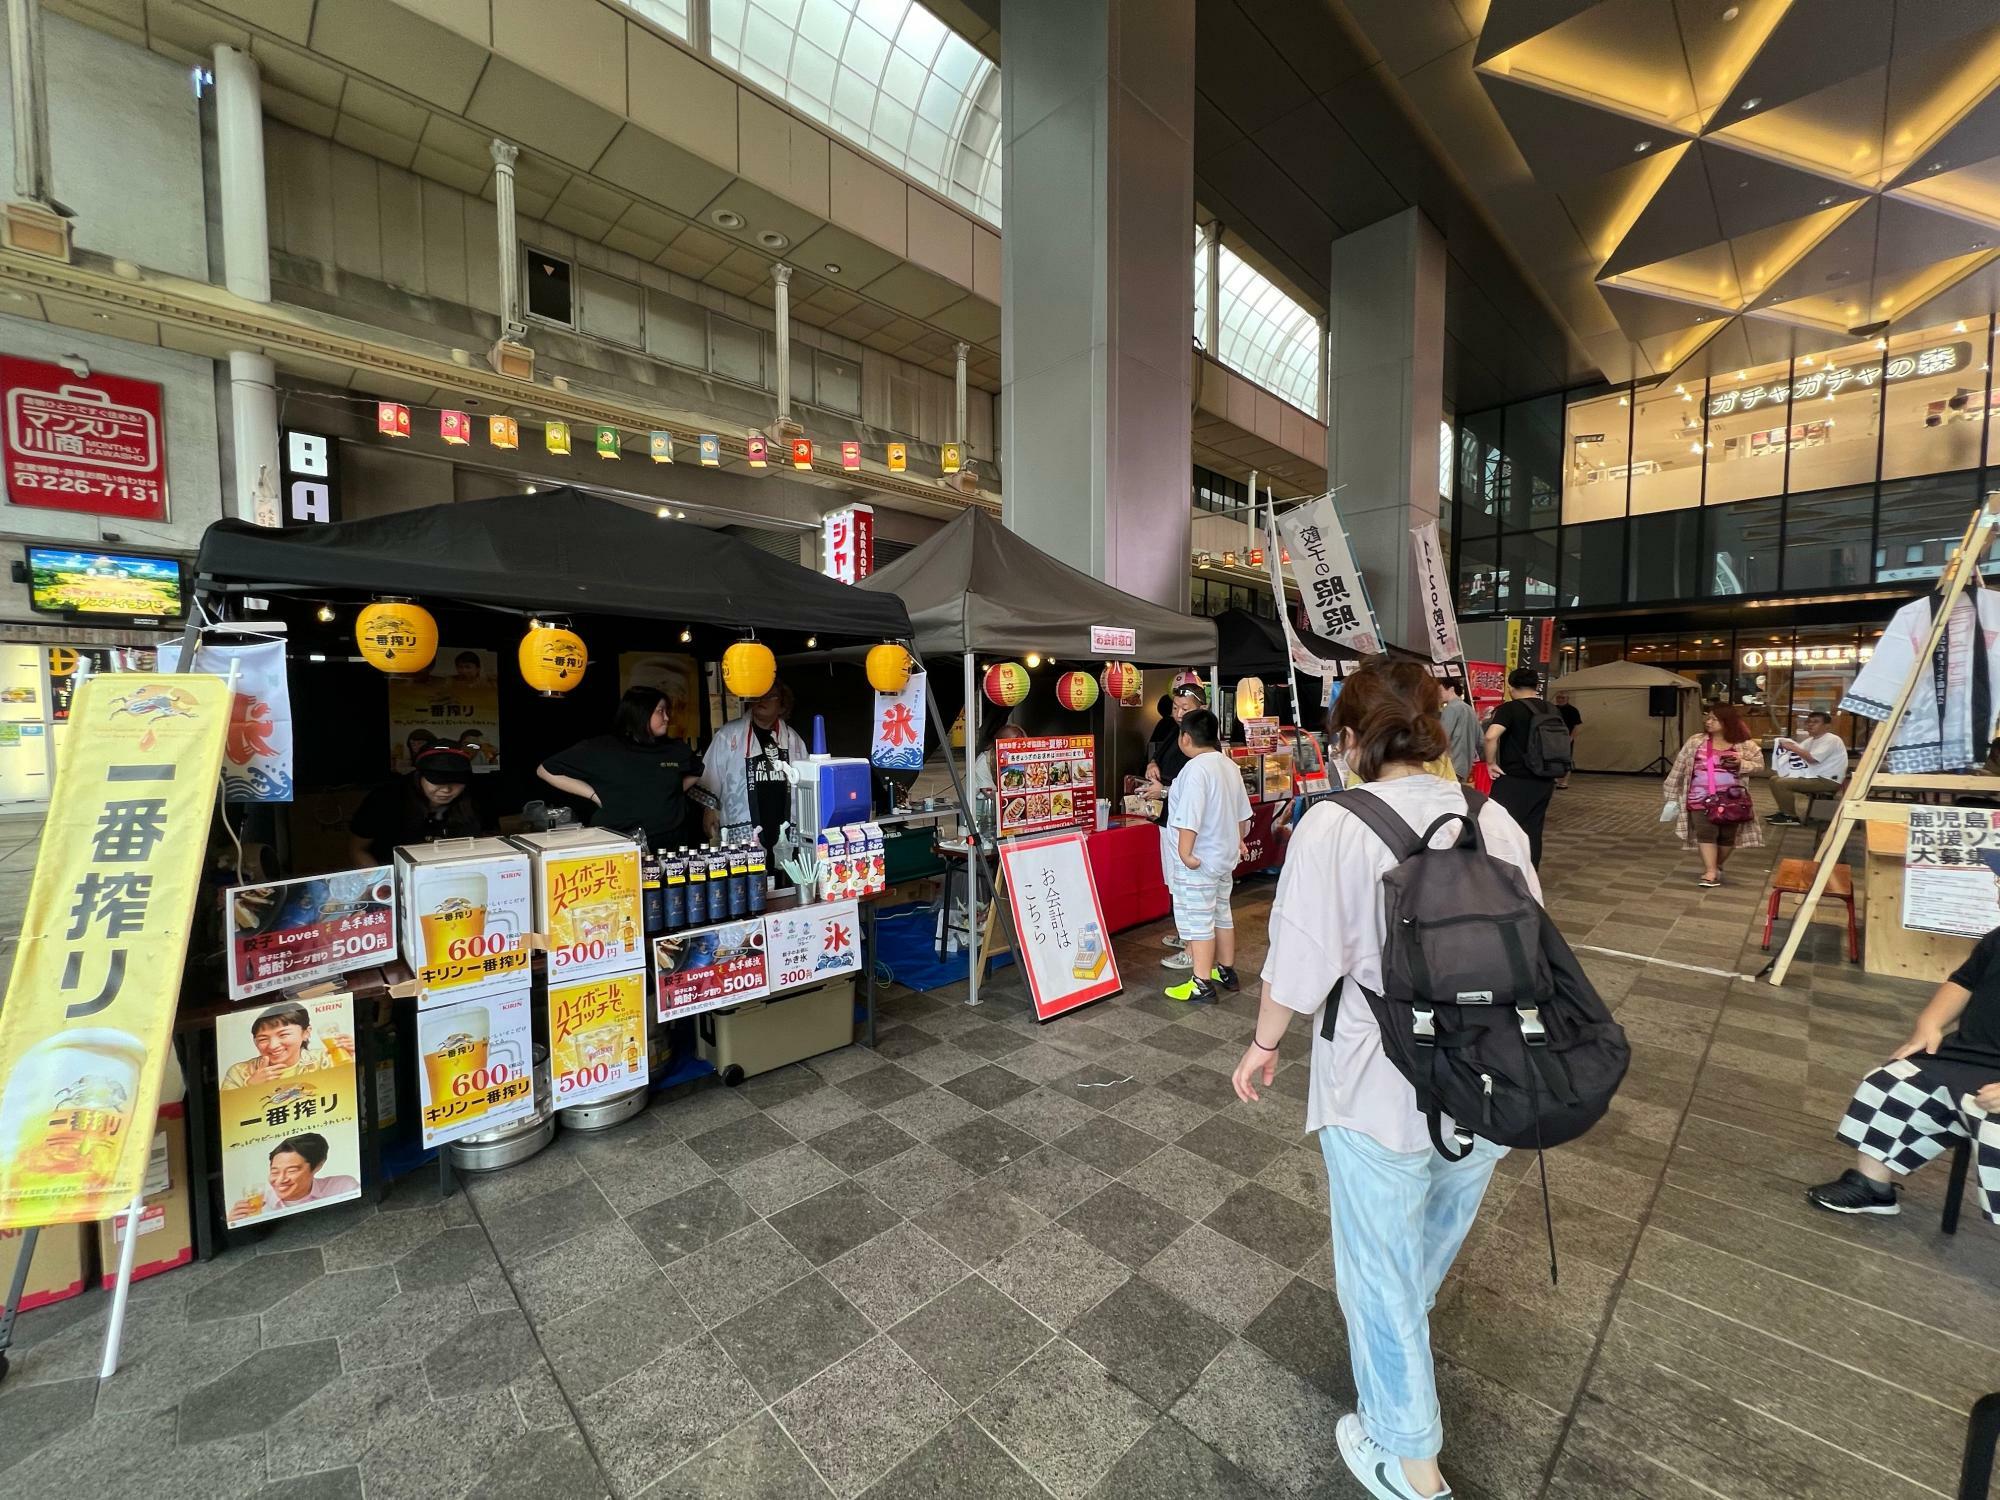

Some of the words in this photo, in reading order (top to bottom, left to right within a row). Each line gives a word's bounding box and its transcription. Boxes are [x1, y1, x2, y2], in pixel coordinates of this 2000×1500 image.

[1711, 347, 1956, 416] ガチャガチャの森
[23, 410, 144, 439] マンスリー
[24, 427, 84, 456] 川商
[85, 439, 141, 455] MONTHLY
[86, 448, 145, 463] KAWASHO
[42, 475, 158, 503] 226-7131
[833, 518, 848, 584] ジャ
[859, 521, 867, 579] KARAOK
[364, 634, 417, 647] 一番搾り
[542, 655, 584, 669] 一番搾り
[880, 702, 918, 746] 氷
[1911, 847, 1985, 866] 大募集
[500, 871, 522, 880] KIRIN
[554, 859, 621, 896] ハイボール、
[60, 763, 177, 1020] 一番搾り
[553, 875, 622, 916] スコッチで。
[434, 909, 473, 922] 一番搾り
[1024, 884, 1046, 944] こちら
[1041, 867, 1072, 949] お会計は
[243, 934, 274, 952] 餃子
[278, 928, 320, 945] Loves
[331, 933, 388, 959] 500円
[448, 932, 521, 961] 600円
[824, 922, 851, 953] 氷
[258, 951, 328, 977] 焼酎ソーダ割り
[555, 939, 617, 967] 500円
[784, 953, 808, 966] かき氷
[421, 952, 527, 983] キリン一番搾り
[686, 969, 715, 982] Loves
[780, 968, 812, 986] 300円
[673, 987, 721, 1006] 焼酎ソーダ割り
[723, 973, 763, 993] 500円
[314, 1001, 343, 1014] KIRIN
[502, 1001, 522, 1010] KIRIN
[557, 983, 624, 1023] ハイボール、
[556, 998, 626, 1043] スコッチで。
[437, 1043, 475, 1059] 一番搾り
[452, 1063, 523, 1097] 600円
[560, 1062, 621, 1093] 500円
[240, 1093, 339, 1128] 一番搾り
[426, 1080, 530, 1122] キリン一番搾り
